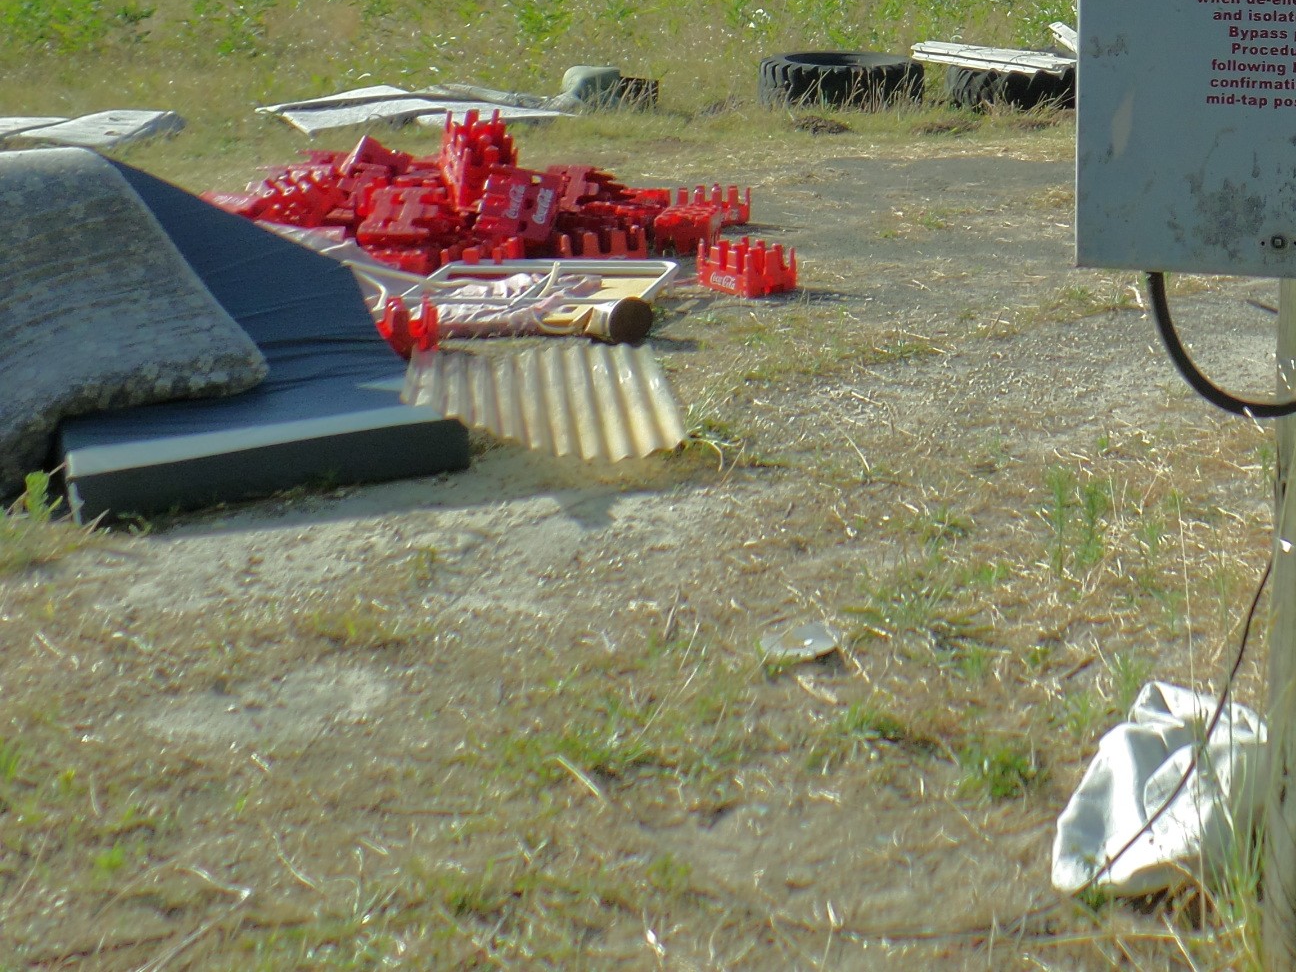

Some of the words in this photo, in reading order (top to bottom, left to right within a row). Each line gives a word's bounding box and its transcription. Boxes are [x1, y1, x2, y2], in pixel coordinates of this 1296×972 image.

[1213, 10, 1242, 21] and
[1229, 26, 1288, 41] Bypass
[1211, 59, 1286, 75] following
[1206, 93, 1268, 109] mid-tap
